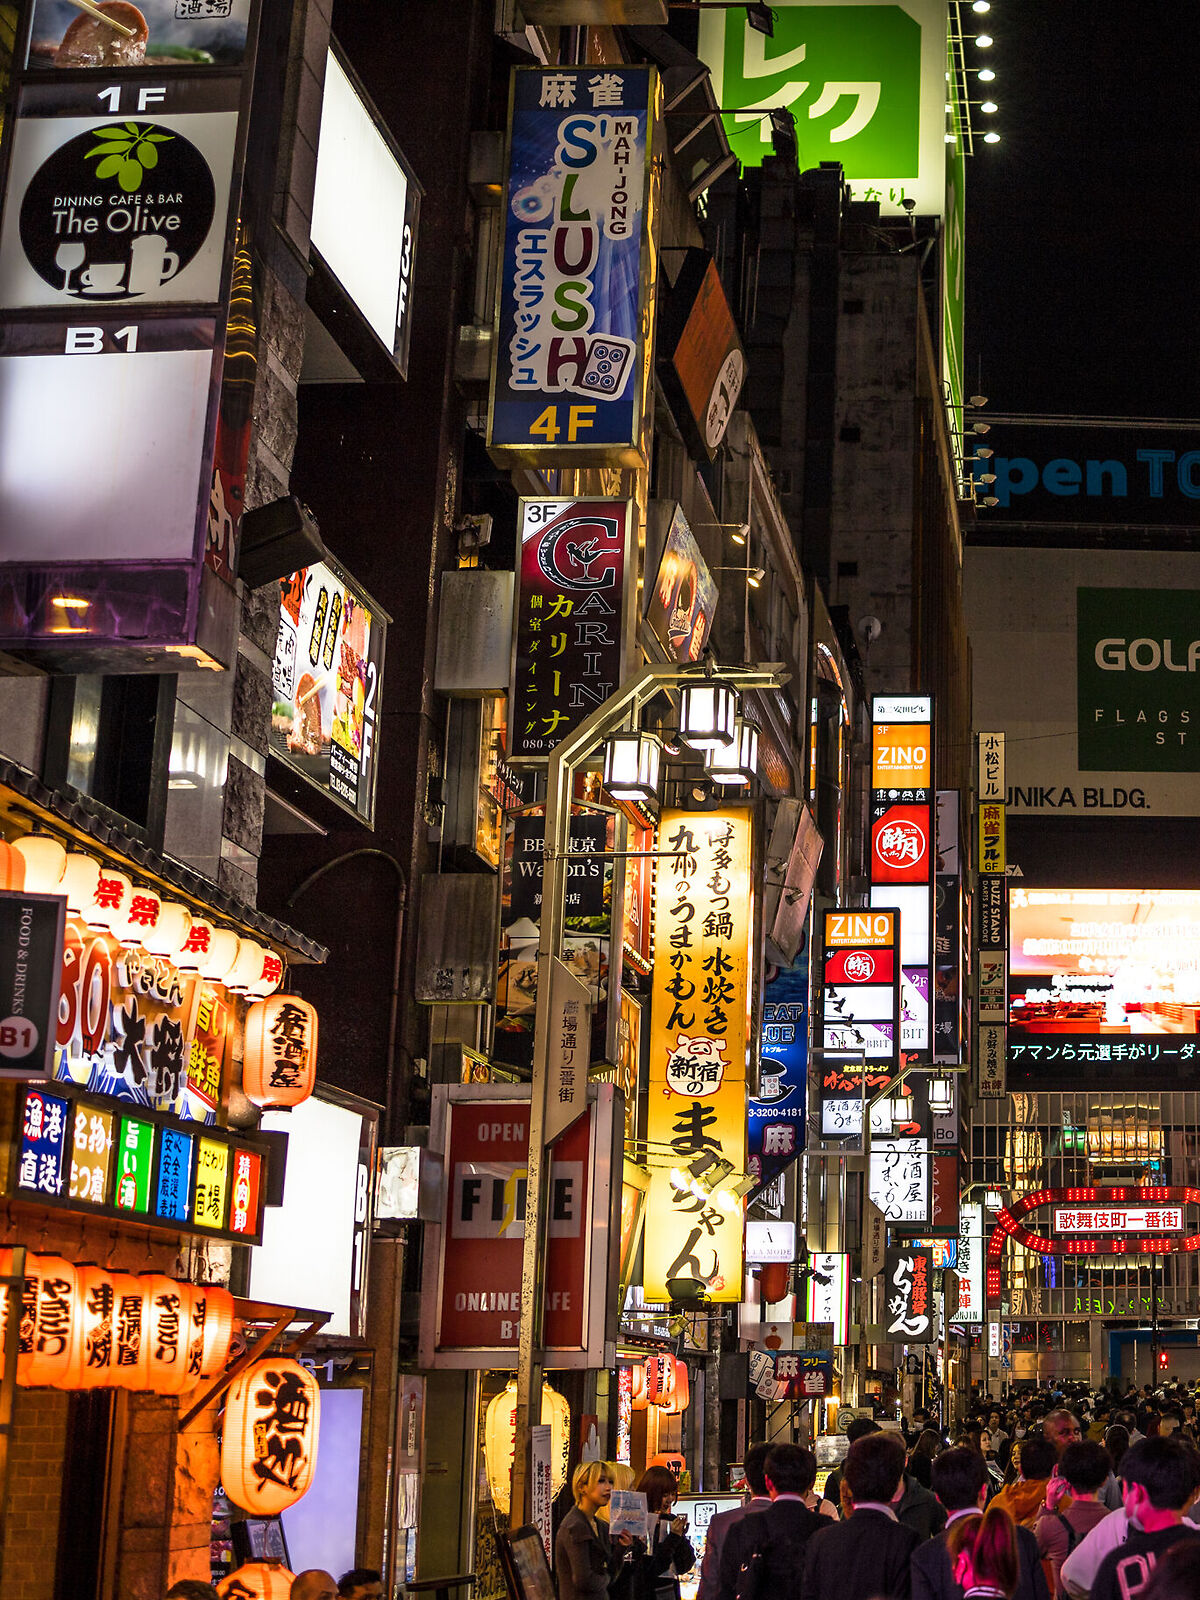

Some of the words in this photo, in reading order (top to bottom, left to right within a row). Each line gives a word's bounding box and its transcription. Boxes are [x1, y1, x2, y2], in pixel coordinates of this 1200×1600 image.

[97, 86, 166, 112] 1F
[538, 74, 624, 108] 麻雀
[608, 120, 632, 236] MAH-JONG
[54, 196, 103, 207] DINING
[109, 195, 142, 206] CAFE
[145, 194, 154, 205] &
[158, 193, 183, 204] BAR
[53, 211, 98, 234] The
[107, 206, 181, 233] Olive
[514, 234, 548, 385] エスラッシュ
[65, 325, 139, 354] B1
[529, 405, 597, 442] 4F
[527, 505, 557, 523] 3F
[523, 594, 543, 736] 個室ダイニング
[541, 594, 575, 737] カリーナ
[877, 726, 889, 734] 5F
[877, 746, 926, 764] ZINO
[984, 736, 999, 796] 小松ビル
[873, 808, 886, 817] 4F
[1083, 788, 1151, 809] BLDG.
[704, 820, 736, 940] 博多もつ鍋
[984, 862, 998, 872] 6F
[95, 879, 125, 909] 祭
[991, 879, 1000, 904] BUZZ
[19, 906, 34, 946] FOOD
[128, 895, 161, 927] 祭
[664, 825, 698, 1031] 九州のうまかもん
[831, 916, 890, 938] ZINO
[991, 907, 1000, 943] STAND
[12, 963, 29, 1015] DRINKS
[702, 946, 736, 1034] 水炊き
[269, 1003, 308, 1088] 居酒屋
[984, 1029, 998, 1078] お好み焼き
[23, 1098, 62, 1144] 漁港
[74, 1113, 105, 1154] 名物
[477, 1123, 525, 1142] OPEN
[18, 1149, 58, 1194] 直送
[118, 1119, 141, 1206] 旨い酒
[902, 1139, 925, 1203] 居酒屋
[1058, 1212, 1179, 1230] 歌舞伎町一番街
[454, 1292, 520, 1313] ONLINE
[803, 1358, 828, 1367] フリー
